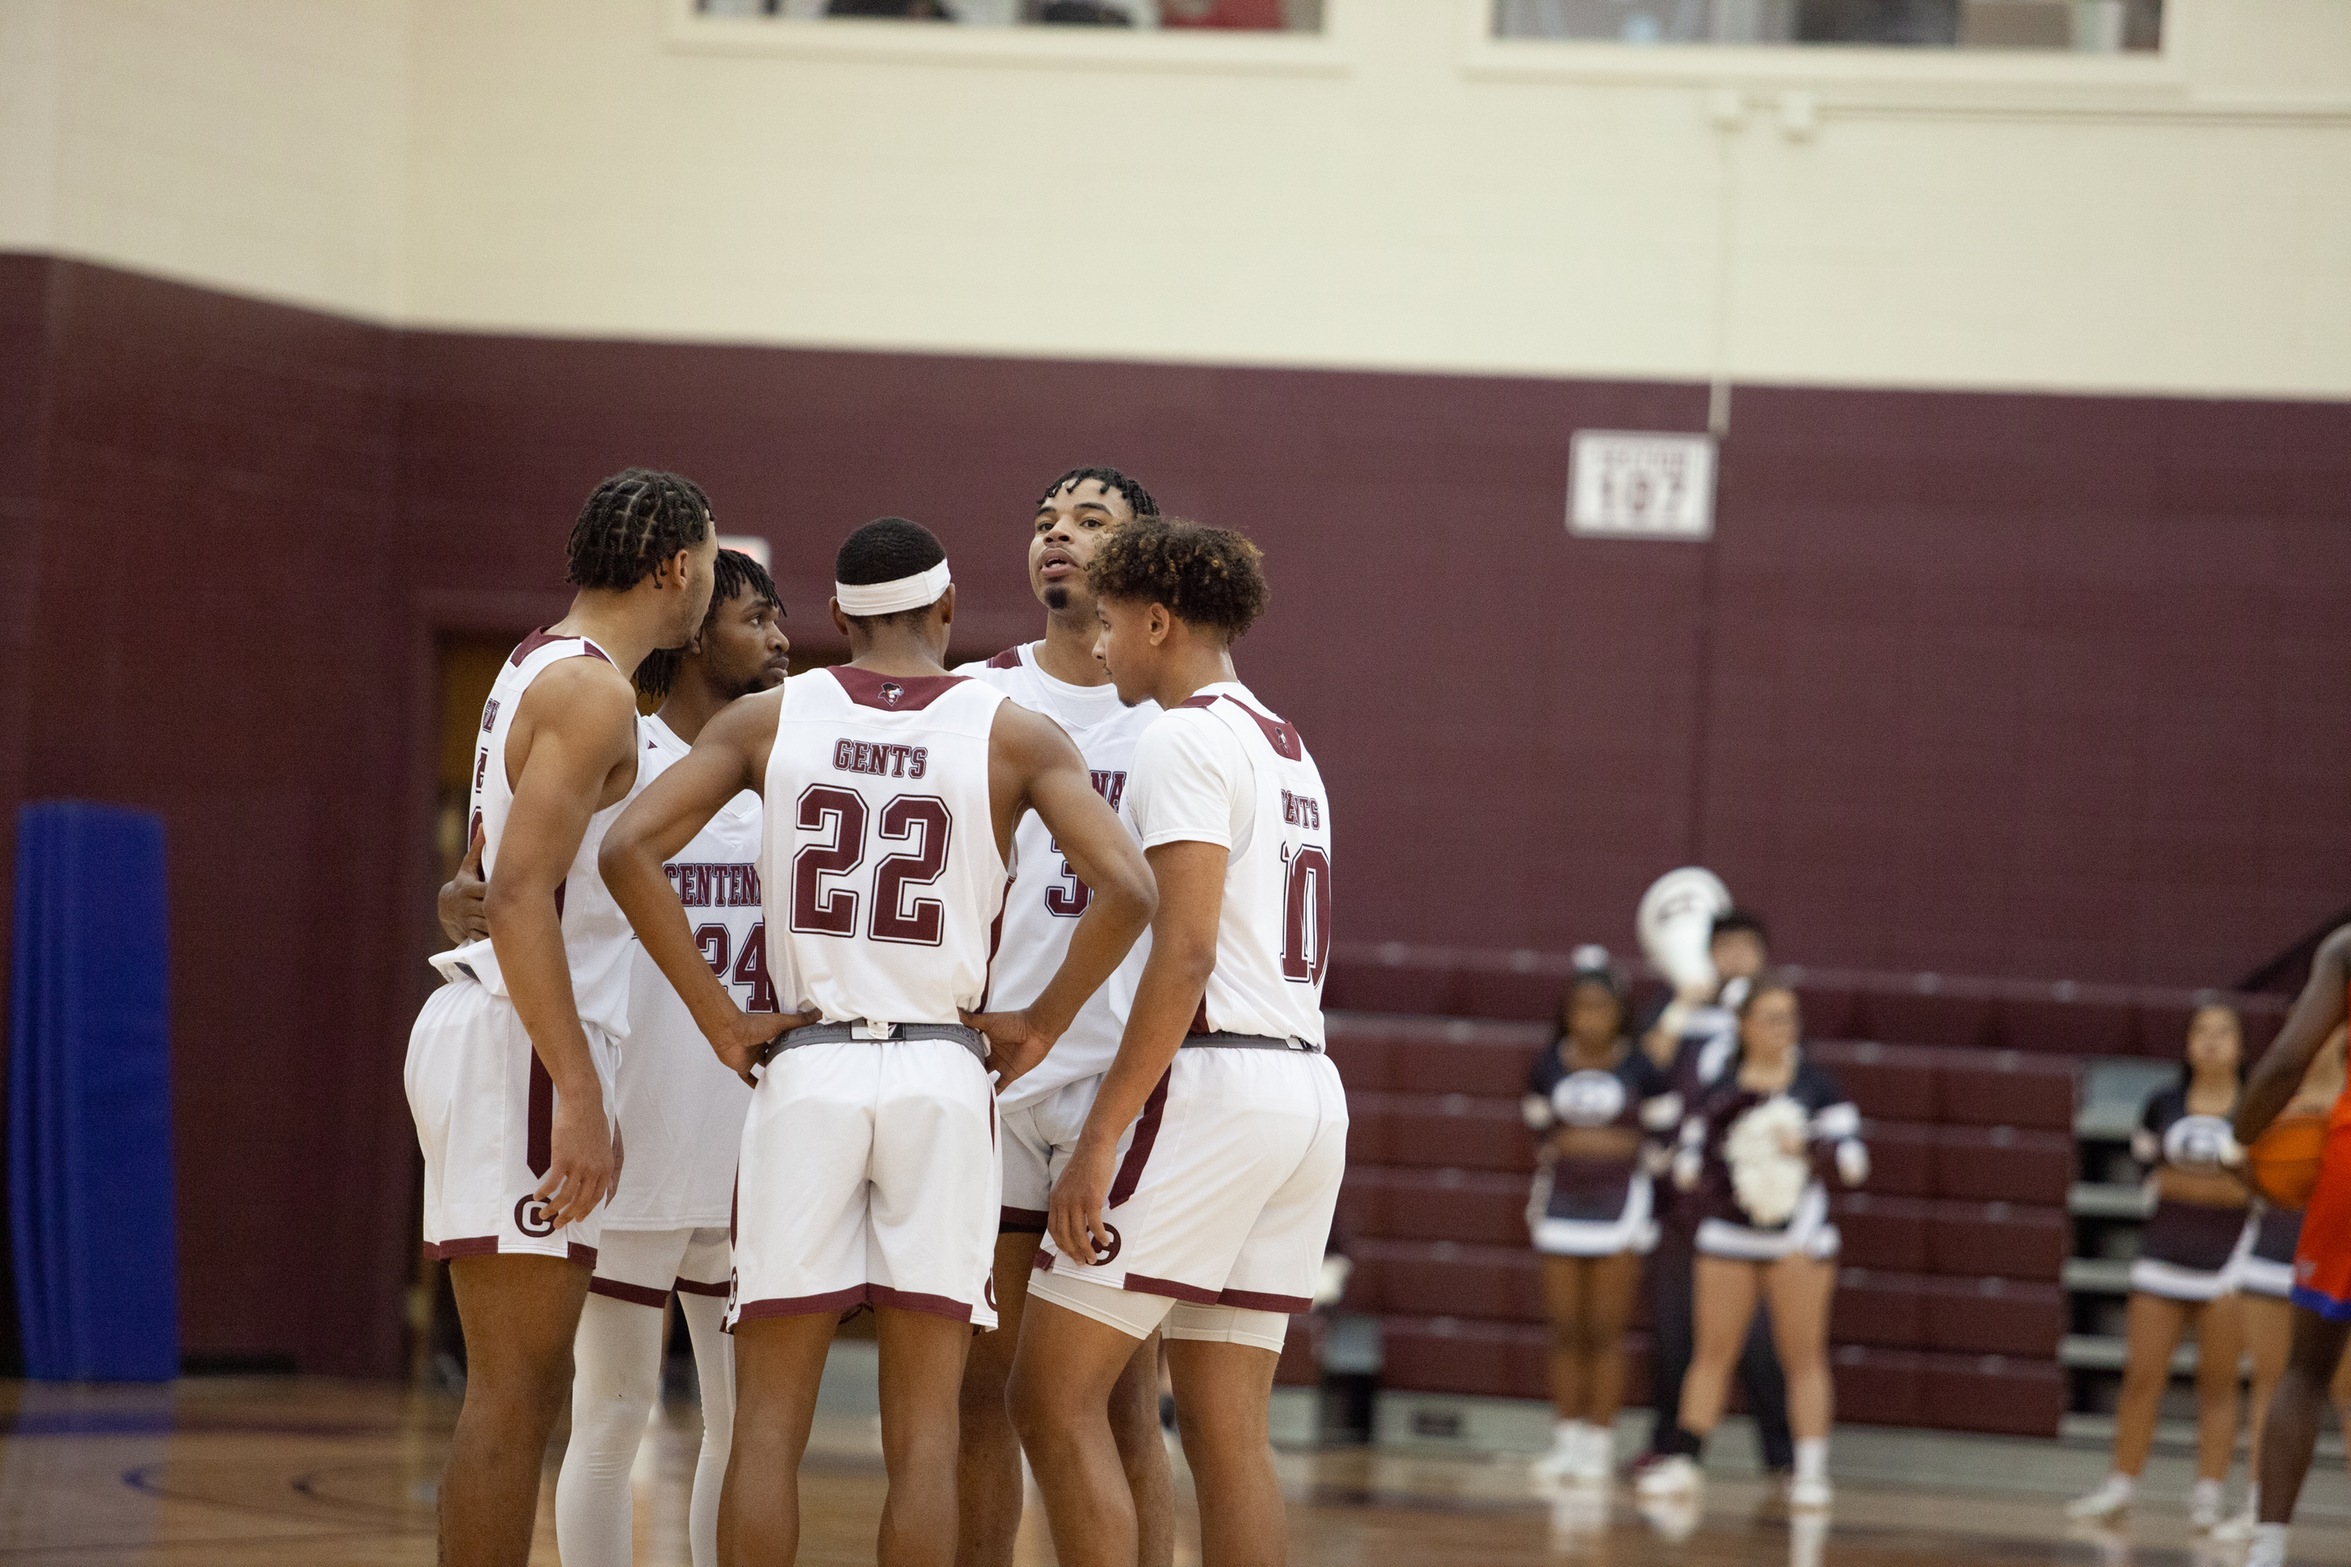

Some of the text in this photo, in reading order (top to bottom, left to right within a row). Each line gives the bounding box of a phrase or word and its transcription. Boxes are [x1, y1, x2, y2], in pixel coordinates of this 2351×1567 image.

[833, 738, 928, 779] GENTS
[790, 783, 952, 946] 22
[1280, 841, 1331, 988] 10
[694, 923, 773, 1014] 24
